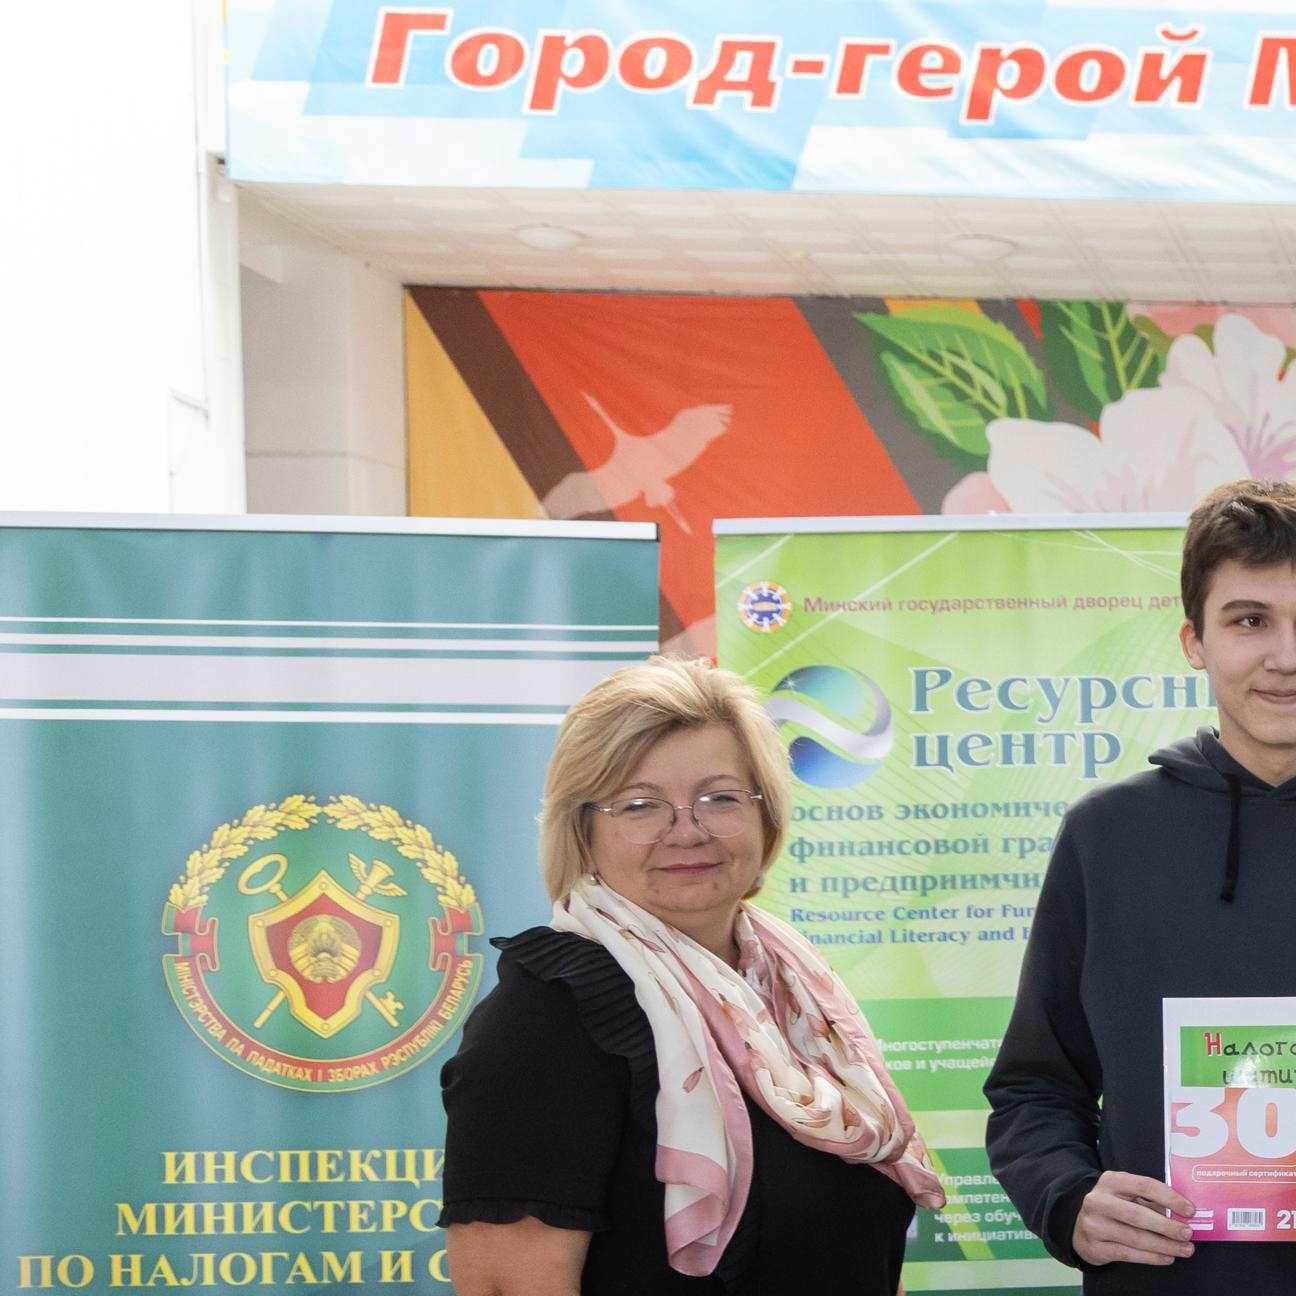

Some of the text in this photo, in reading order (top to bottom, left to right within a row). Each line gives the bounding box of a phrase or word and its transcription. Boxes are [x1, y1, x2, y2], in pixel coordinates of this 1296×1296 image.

[370, 10, 1210, 121] Город-герой
[803, 595, 892, 613] Минский
[896, 594, 1068, 616] государственный
[1073, 593, 1142, 611] дворец
[912, 732, 1121, 778] центр
[789, 833, 990, 863] финансовой
[789, 876, 807, 893] и
[790, 904, 994, 922] Resource Center for
[889, 928, 970, 945] Literacy
[977, 927, 1016, 942] and
[17, 1254, 94, 1289] ПО
[108, 1251, 365, 1287] НАЛОГАМ
[378, 1250, 414, 1283] И
